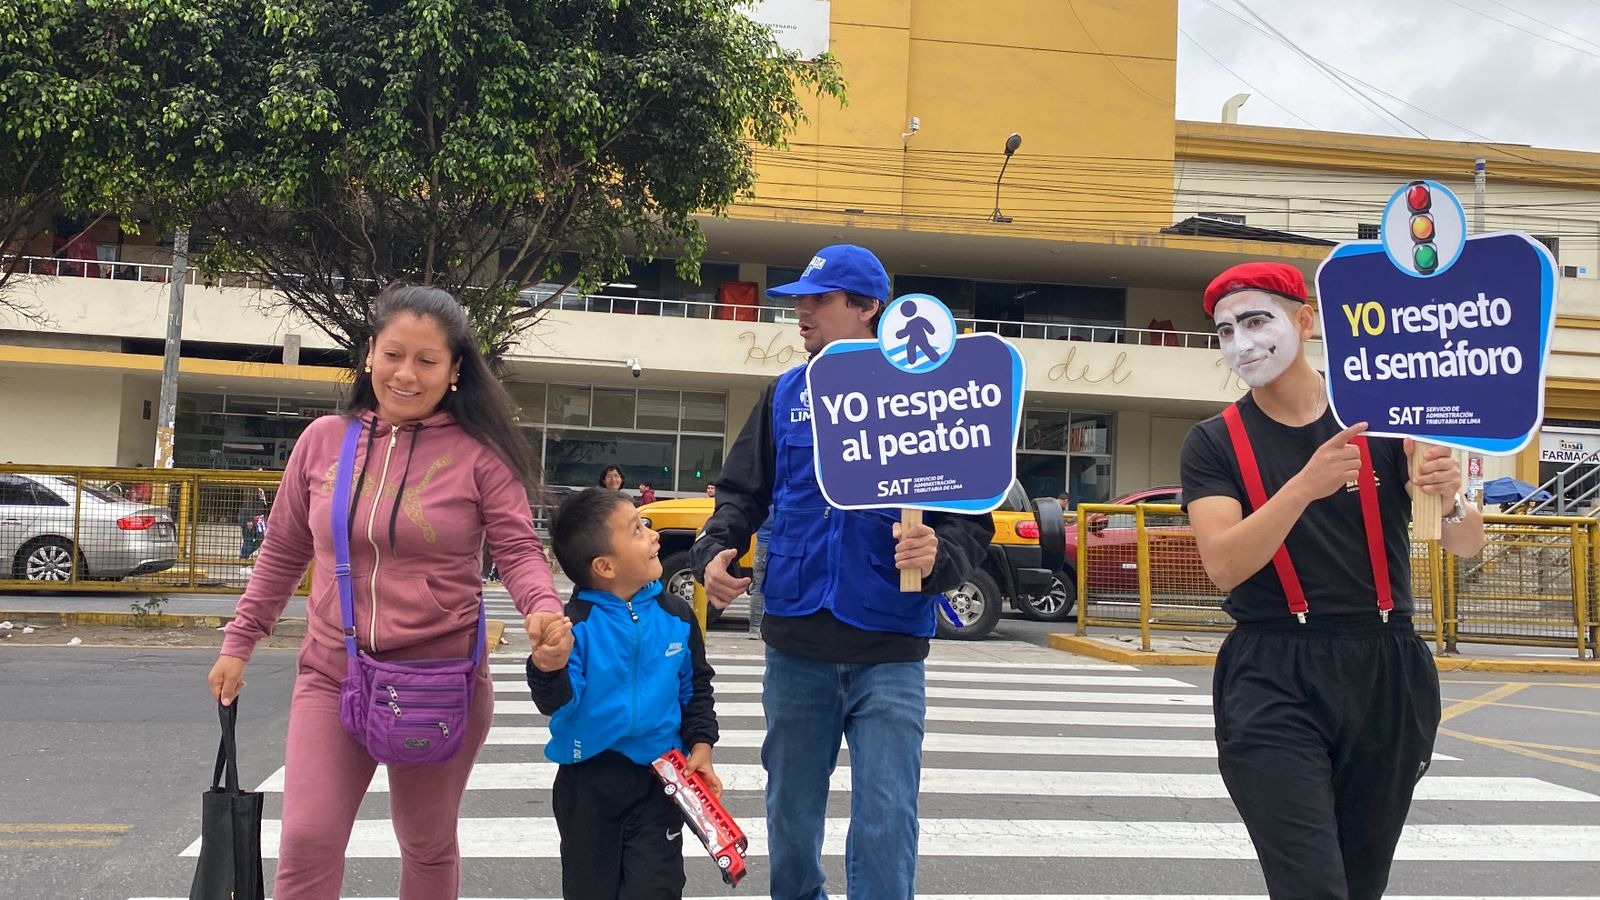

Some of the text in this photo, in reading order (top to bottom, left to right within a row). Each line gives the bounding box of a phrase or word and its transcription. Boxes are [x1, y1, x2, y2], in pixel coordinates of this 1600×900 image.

[1342, 292, 1512, 339] YO respeto
[1047, 345, 1133, 384] del
[1344, 340, 1523, 381] el semáforo
[821, 380, 1002, 425] YO respeto
[790, 411, 811, 423] LIM
[1388, 406, 1424, 425] SAT
[1425, 411, 1474, 419] ADMINISTRACIÓN
[842, 418, 992, 466] al peatón
[877, 478, 912, 497] SAT
[913, 479, 956, 488] ADMINISTRACIÓN
[913, 486, 943, 494] TRIBUTARIA
